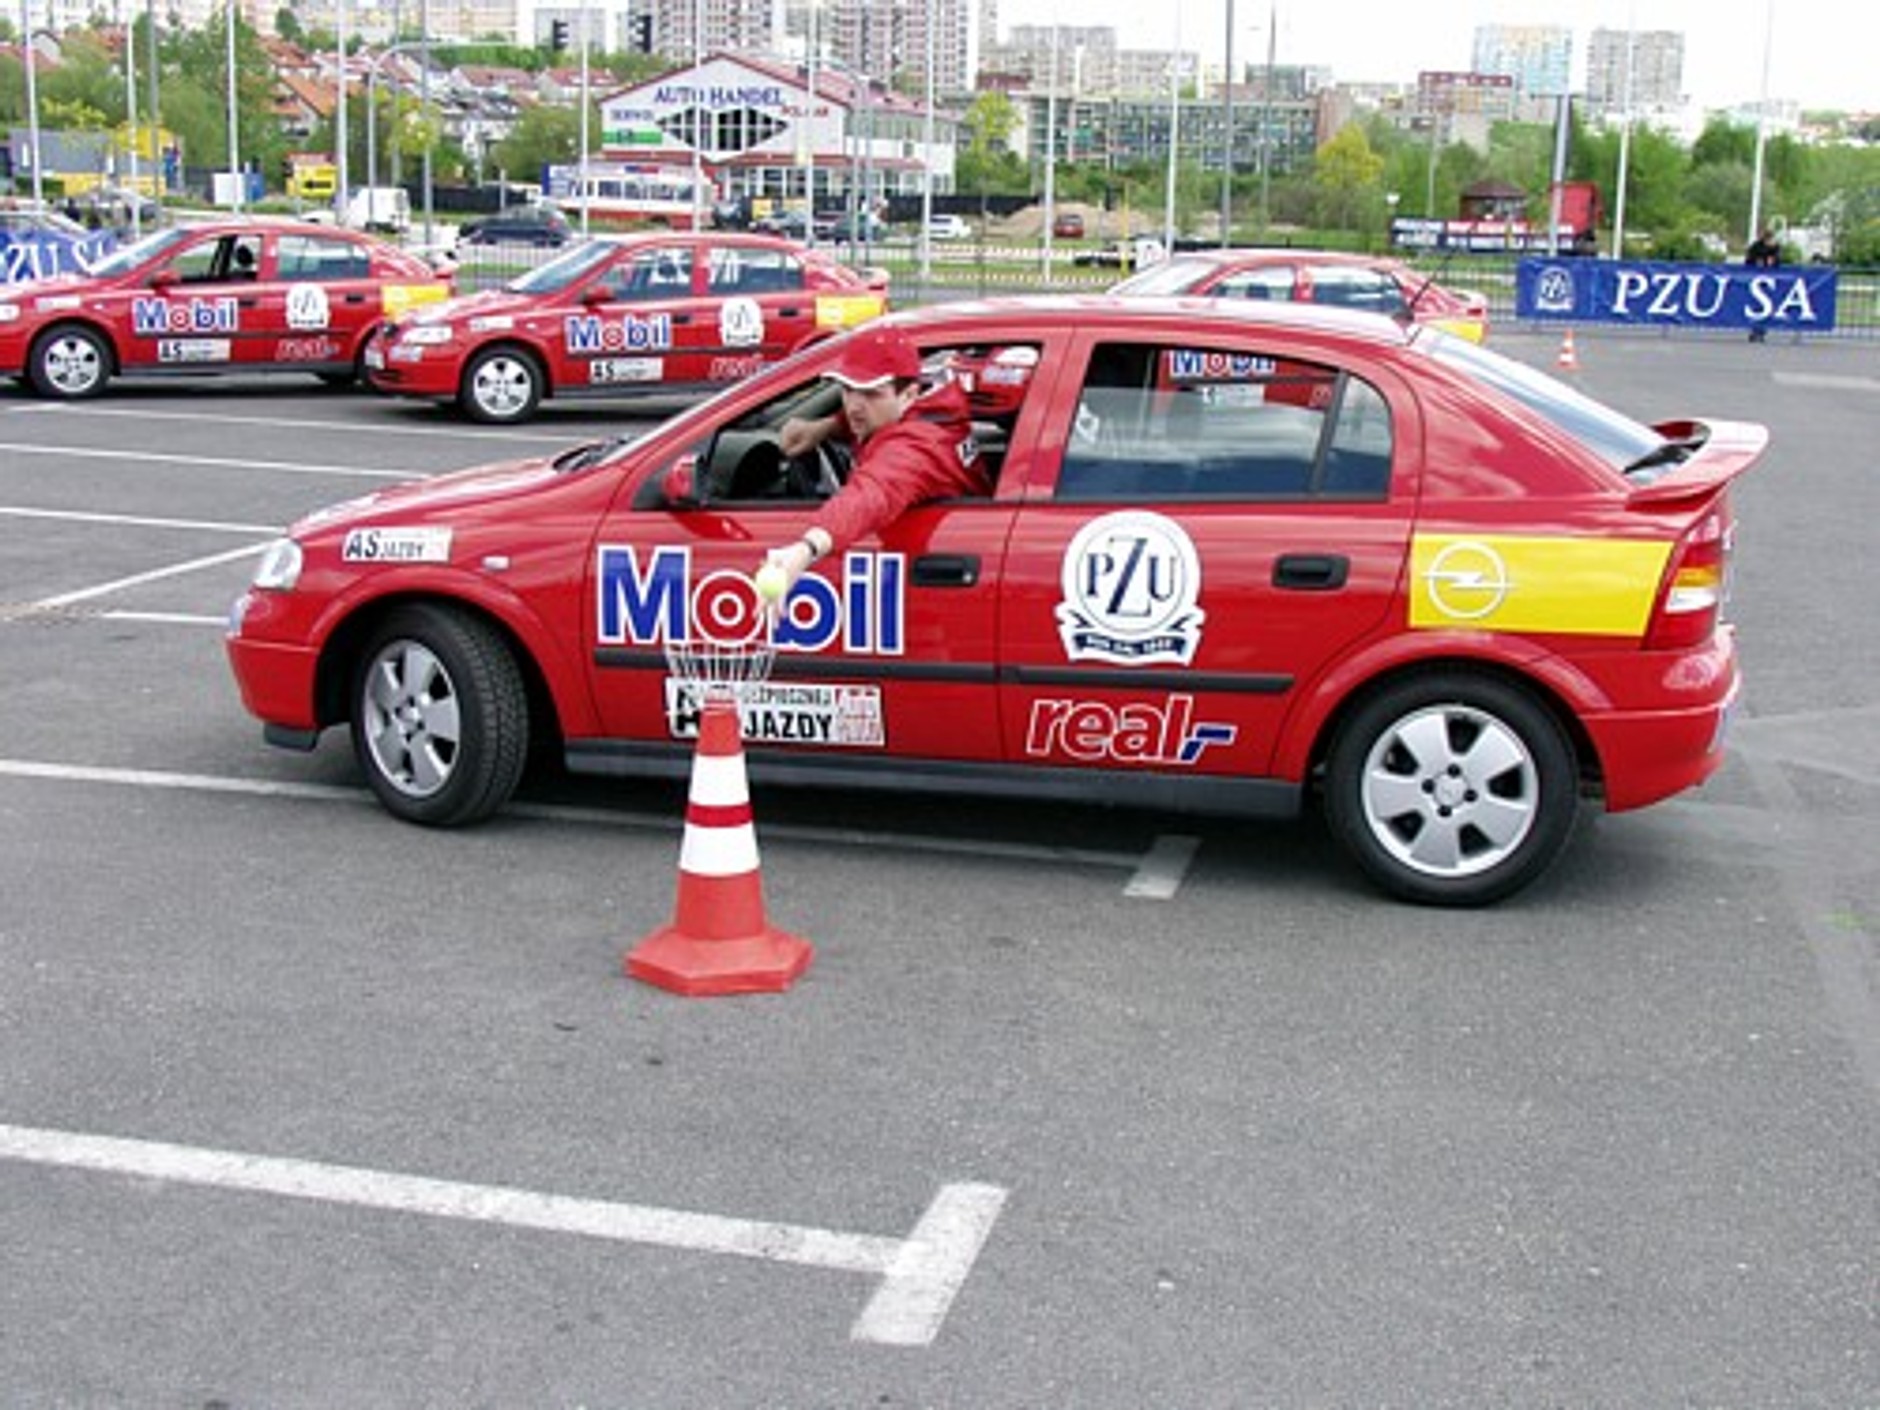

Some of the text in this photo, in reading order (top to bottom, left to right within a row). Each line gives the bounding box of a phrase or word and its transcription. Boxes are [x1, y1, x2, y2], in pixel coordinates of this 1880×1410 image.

[654, 85, 784, 108] AUTO HANDEL
[132, 297, 239, 332] Mobil
[1612, 269, 1817, 321] PZU SA
[566, 312, 672, 354] Mobil
[1085, 537, 1177, 618] PZU
[597, 544, 905, 656] Mobil
[744, 709, 832, 740] JAZDY
